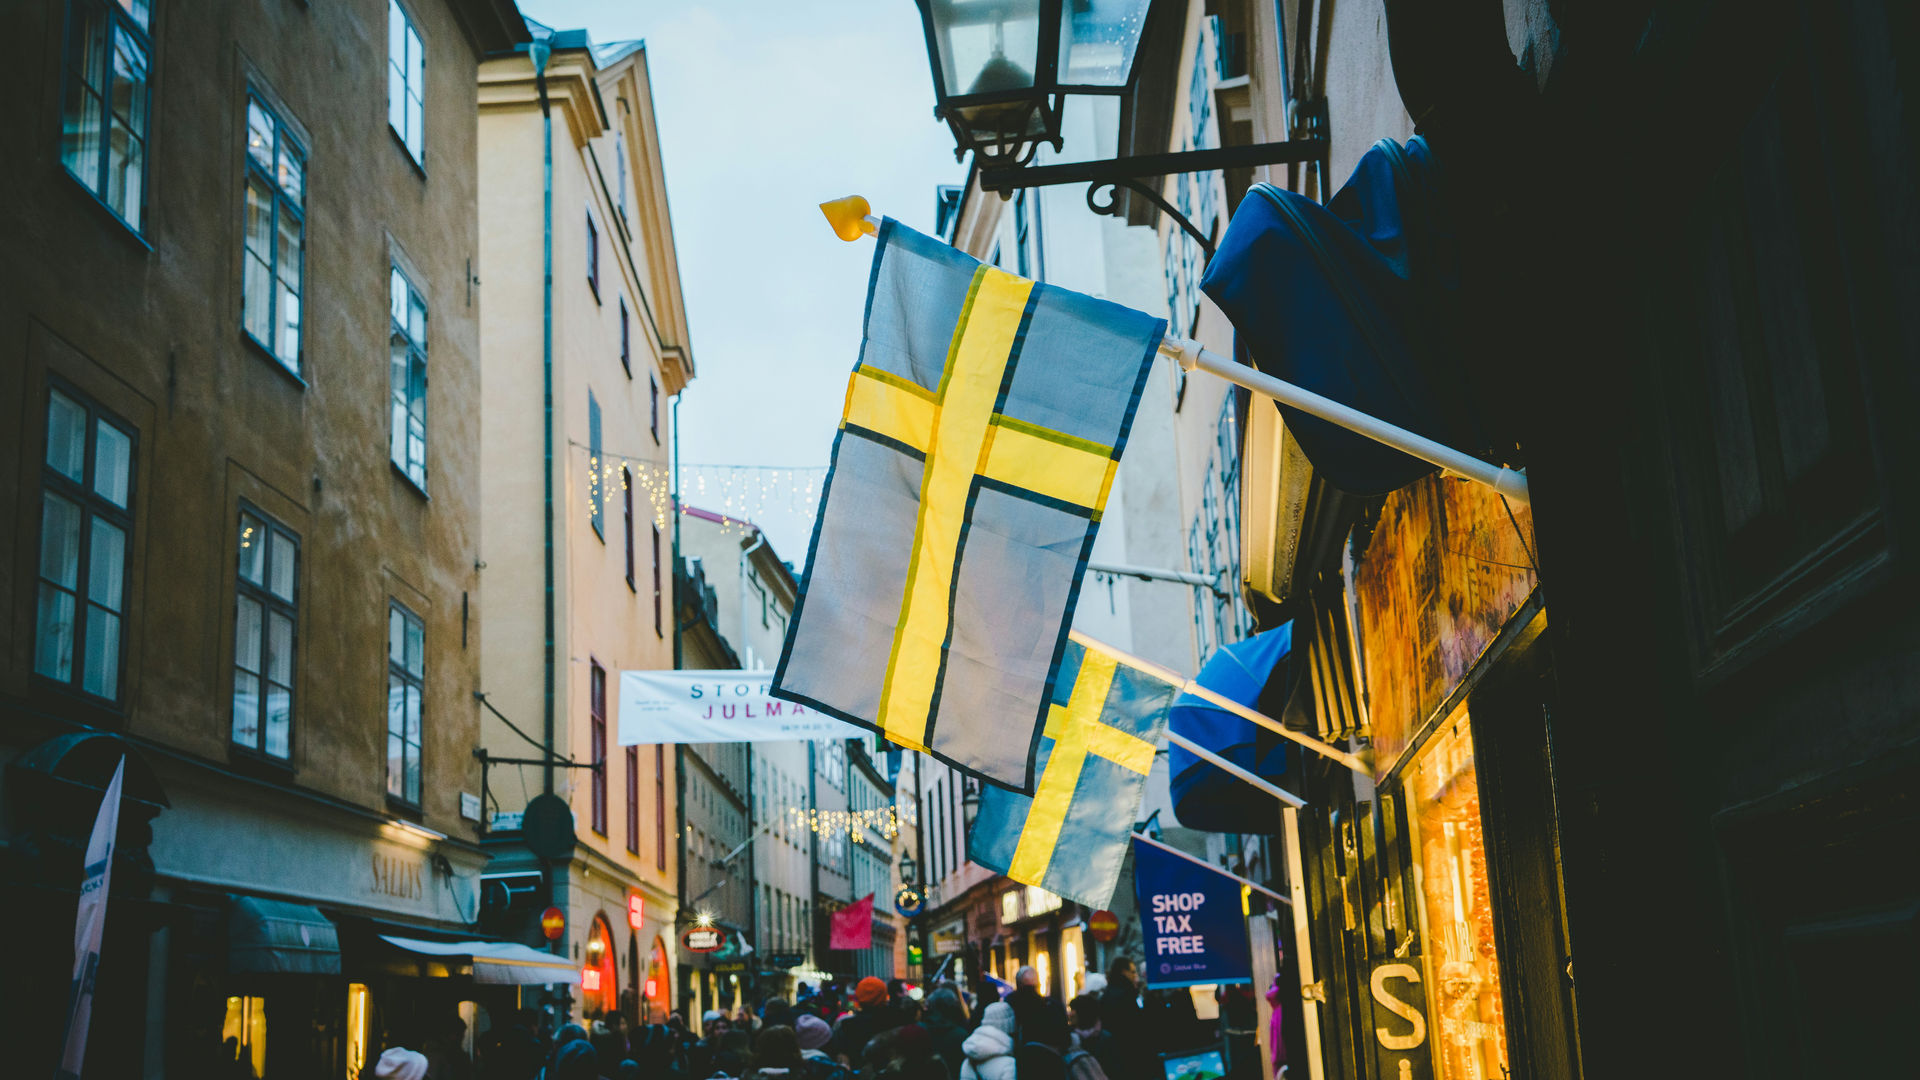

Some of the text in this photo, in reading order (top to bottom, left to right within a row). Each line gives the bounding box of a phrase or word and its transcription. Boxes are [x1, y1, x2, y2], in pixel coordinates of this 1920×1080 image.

[702, 701, 819, 719] JULMA
[1152, 893, 1205, 913] SHOP
[1153, 915, 1192, 934] TAX
[1156, 935, 1205, 955] FREE
